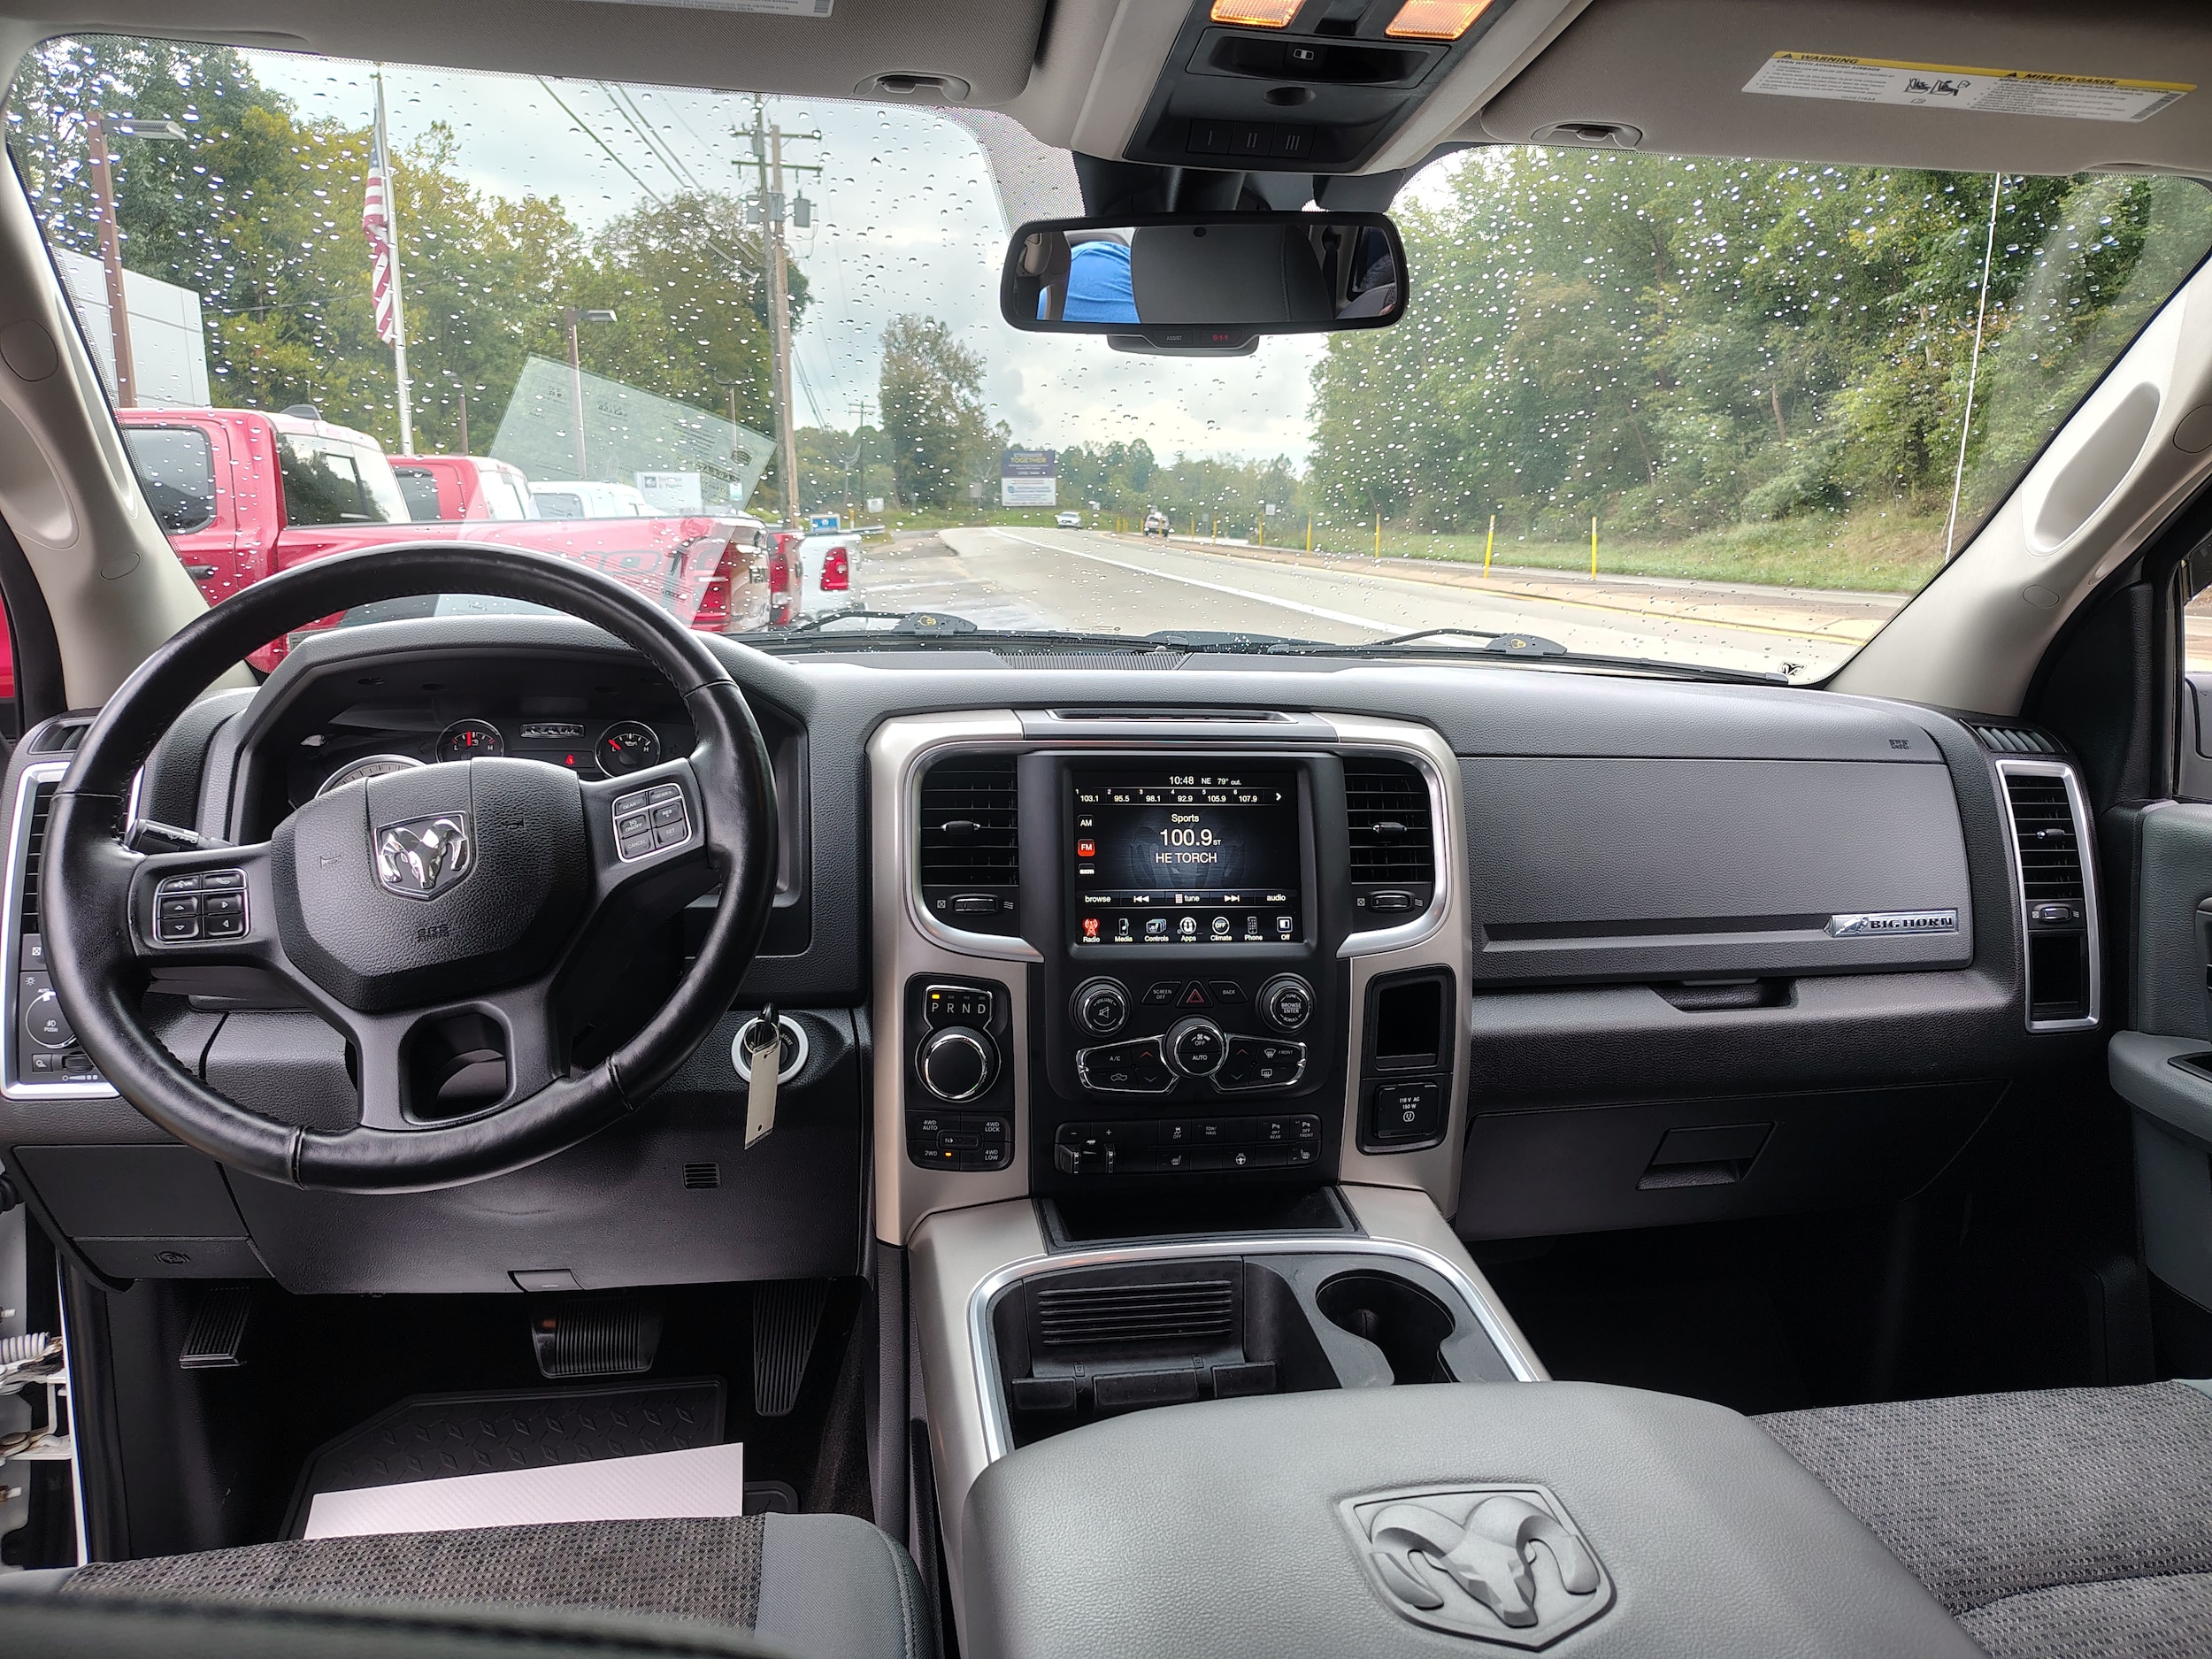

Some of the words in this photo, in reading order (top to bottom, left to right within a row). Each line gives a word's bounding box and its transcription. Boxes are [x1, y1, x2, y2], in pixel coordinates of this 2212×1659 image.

[1801, 55, 1860, 64] WARNING
[1169, 776, 1194, 785] 10:48
[1171, 814, 1200, 823] Sports
[626, 823, 642, 832] ON/OFF
[1160, 829, 1212, 846] 100.9
[627, 840, 646, 849] CANCEL
[1156, 853, 1171, 864] HE
[1175, 853, 1217, 864] TORCH
[1870, 920, 1901, 929] BIG
[1903, 917, 1953, 927] HORN
[932, 1002, 939, 1012] P
[947, 1003, 954, 1013] R
[962, 1003, 970, 1013] N
[978, 1004, 986, 1014] D
[780, 1033, 793, 1045] START
